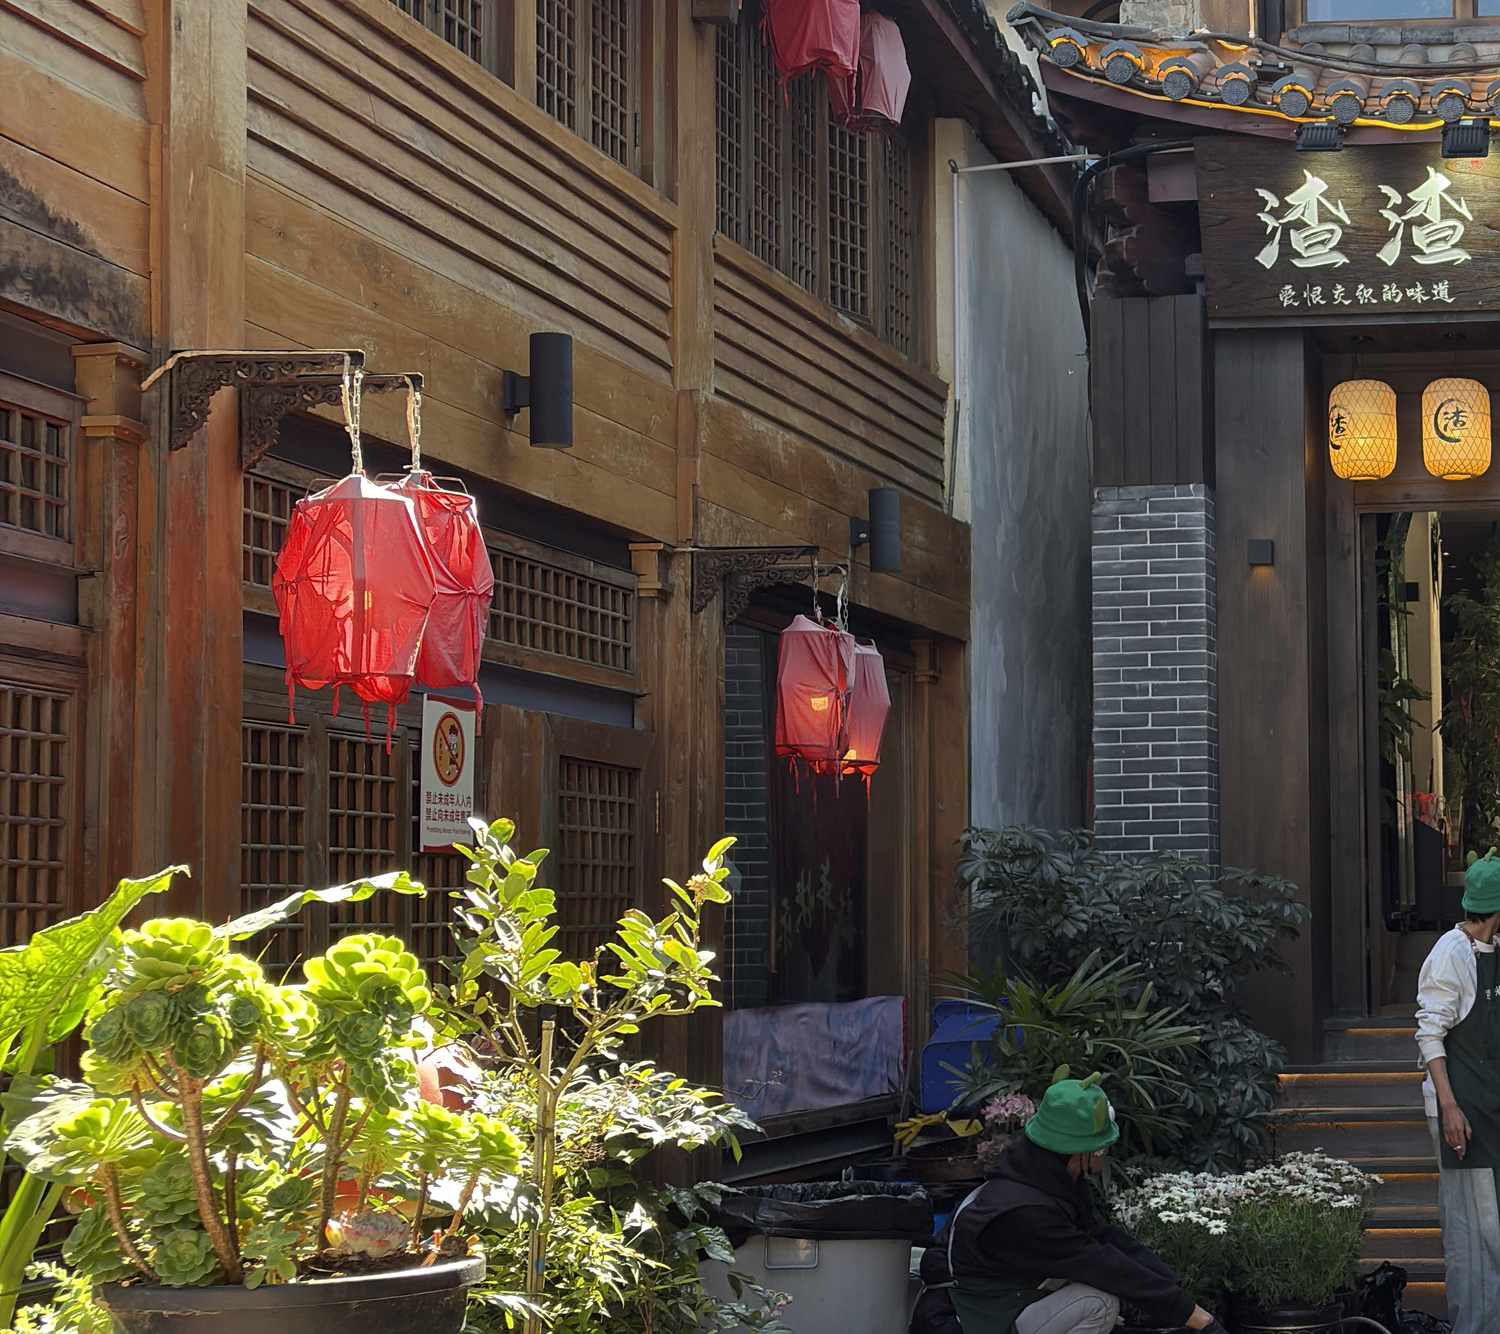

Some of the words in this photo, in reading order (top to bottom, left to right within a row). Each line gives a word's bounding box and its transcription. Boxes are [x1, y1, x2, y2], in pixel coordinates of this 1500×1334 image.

[1279, 279, 1456, 307] 爱恨交织的味道
[1442, 407, 1468, 432] 渣
[426, 791, 471, 808] 禁止未成年人入内
